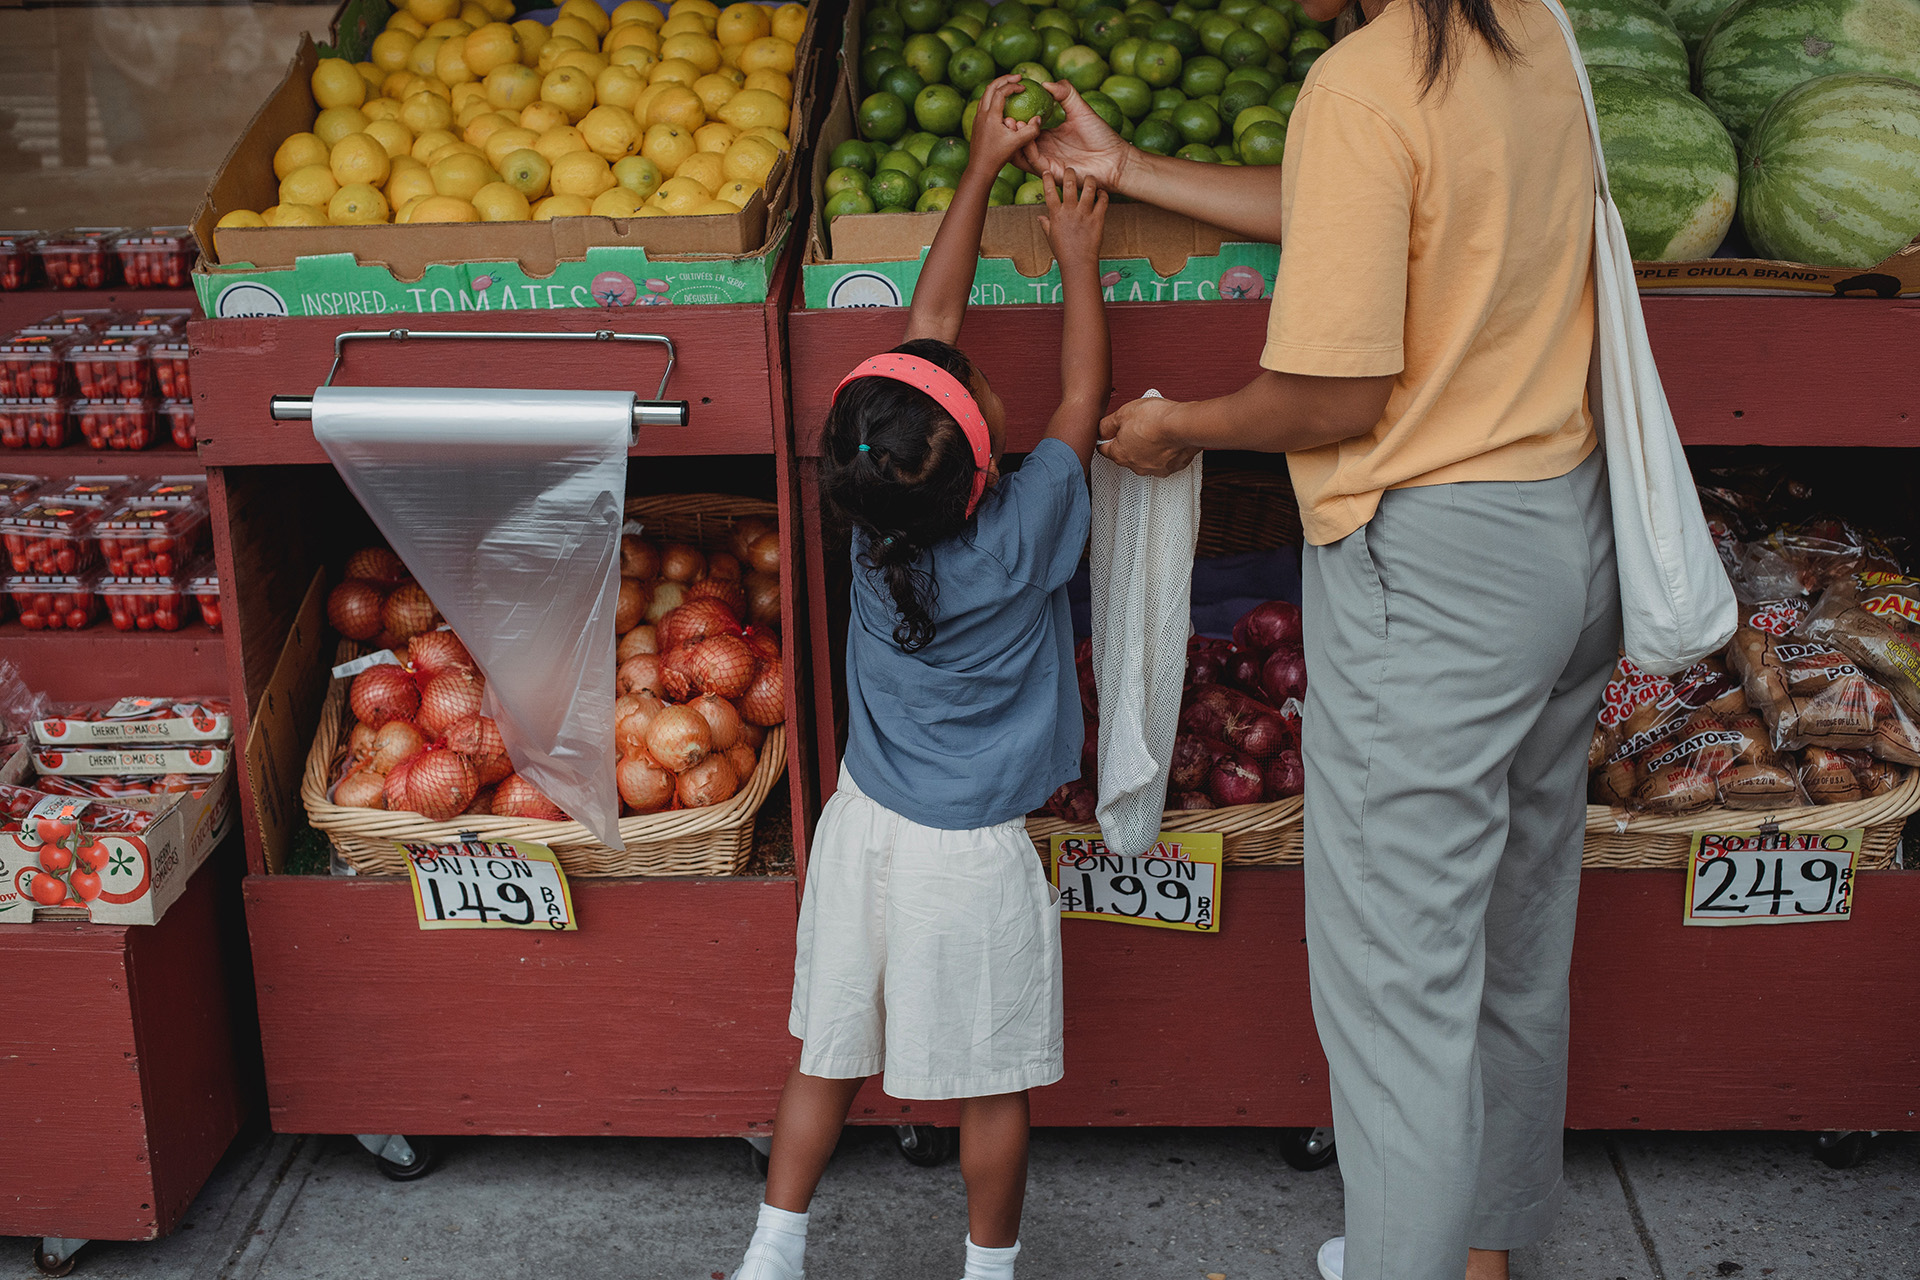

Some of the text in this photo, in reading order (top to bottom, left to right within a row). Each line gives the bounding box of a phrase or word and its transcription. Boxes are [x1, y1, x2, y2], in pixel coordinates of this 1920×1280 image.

[715, 273, 725, 282] EN
[726, 276, 748, 291] SERRE
[1634, 268, 1680, 279] PPLE
[1687, 267, 1748, 278] CHULA
[406, 285, 588, 314] TOMATES
[91, 722, 170, 737] CHERRY TOMATOES
[89, 753, 166, 767] CHERRY TOMATOES
[1648, 731, 1745, 772] POTATOES
[1700, 832, 1848, 856] POTATO
[415, 856, 533, 880] ONION
[1074, 855, 1196, 881] ONION
[1061, 873, 1192, 923] $1.99
[1694, 857, 1838, 915] 2.49
[1835, 868, 1853, 915] BAG
[427, 878, 535, 925] 1.49
[540, 886, 566, 931] BAG
[1194, 896, 1213, 931] BAG
